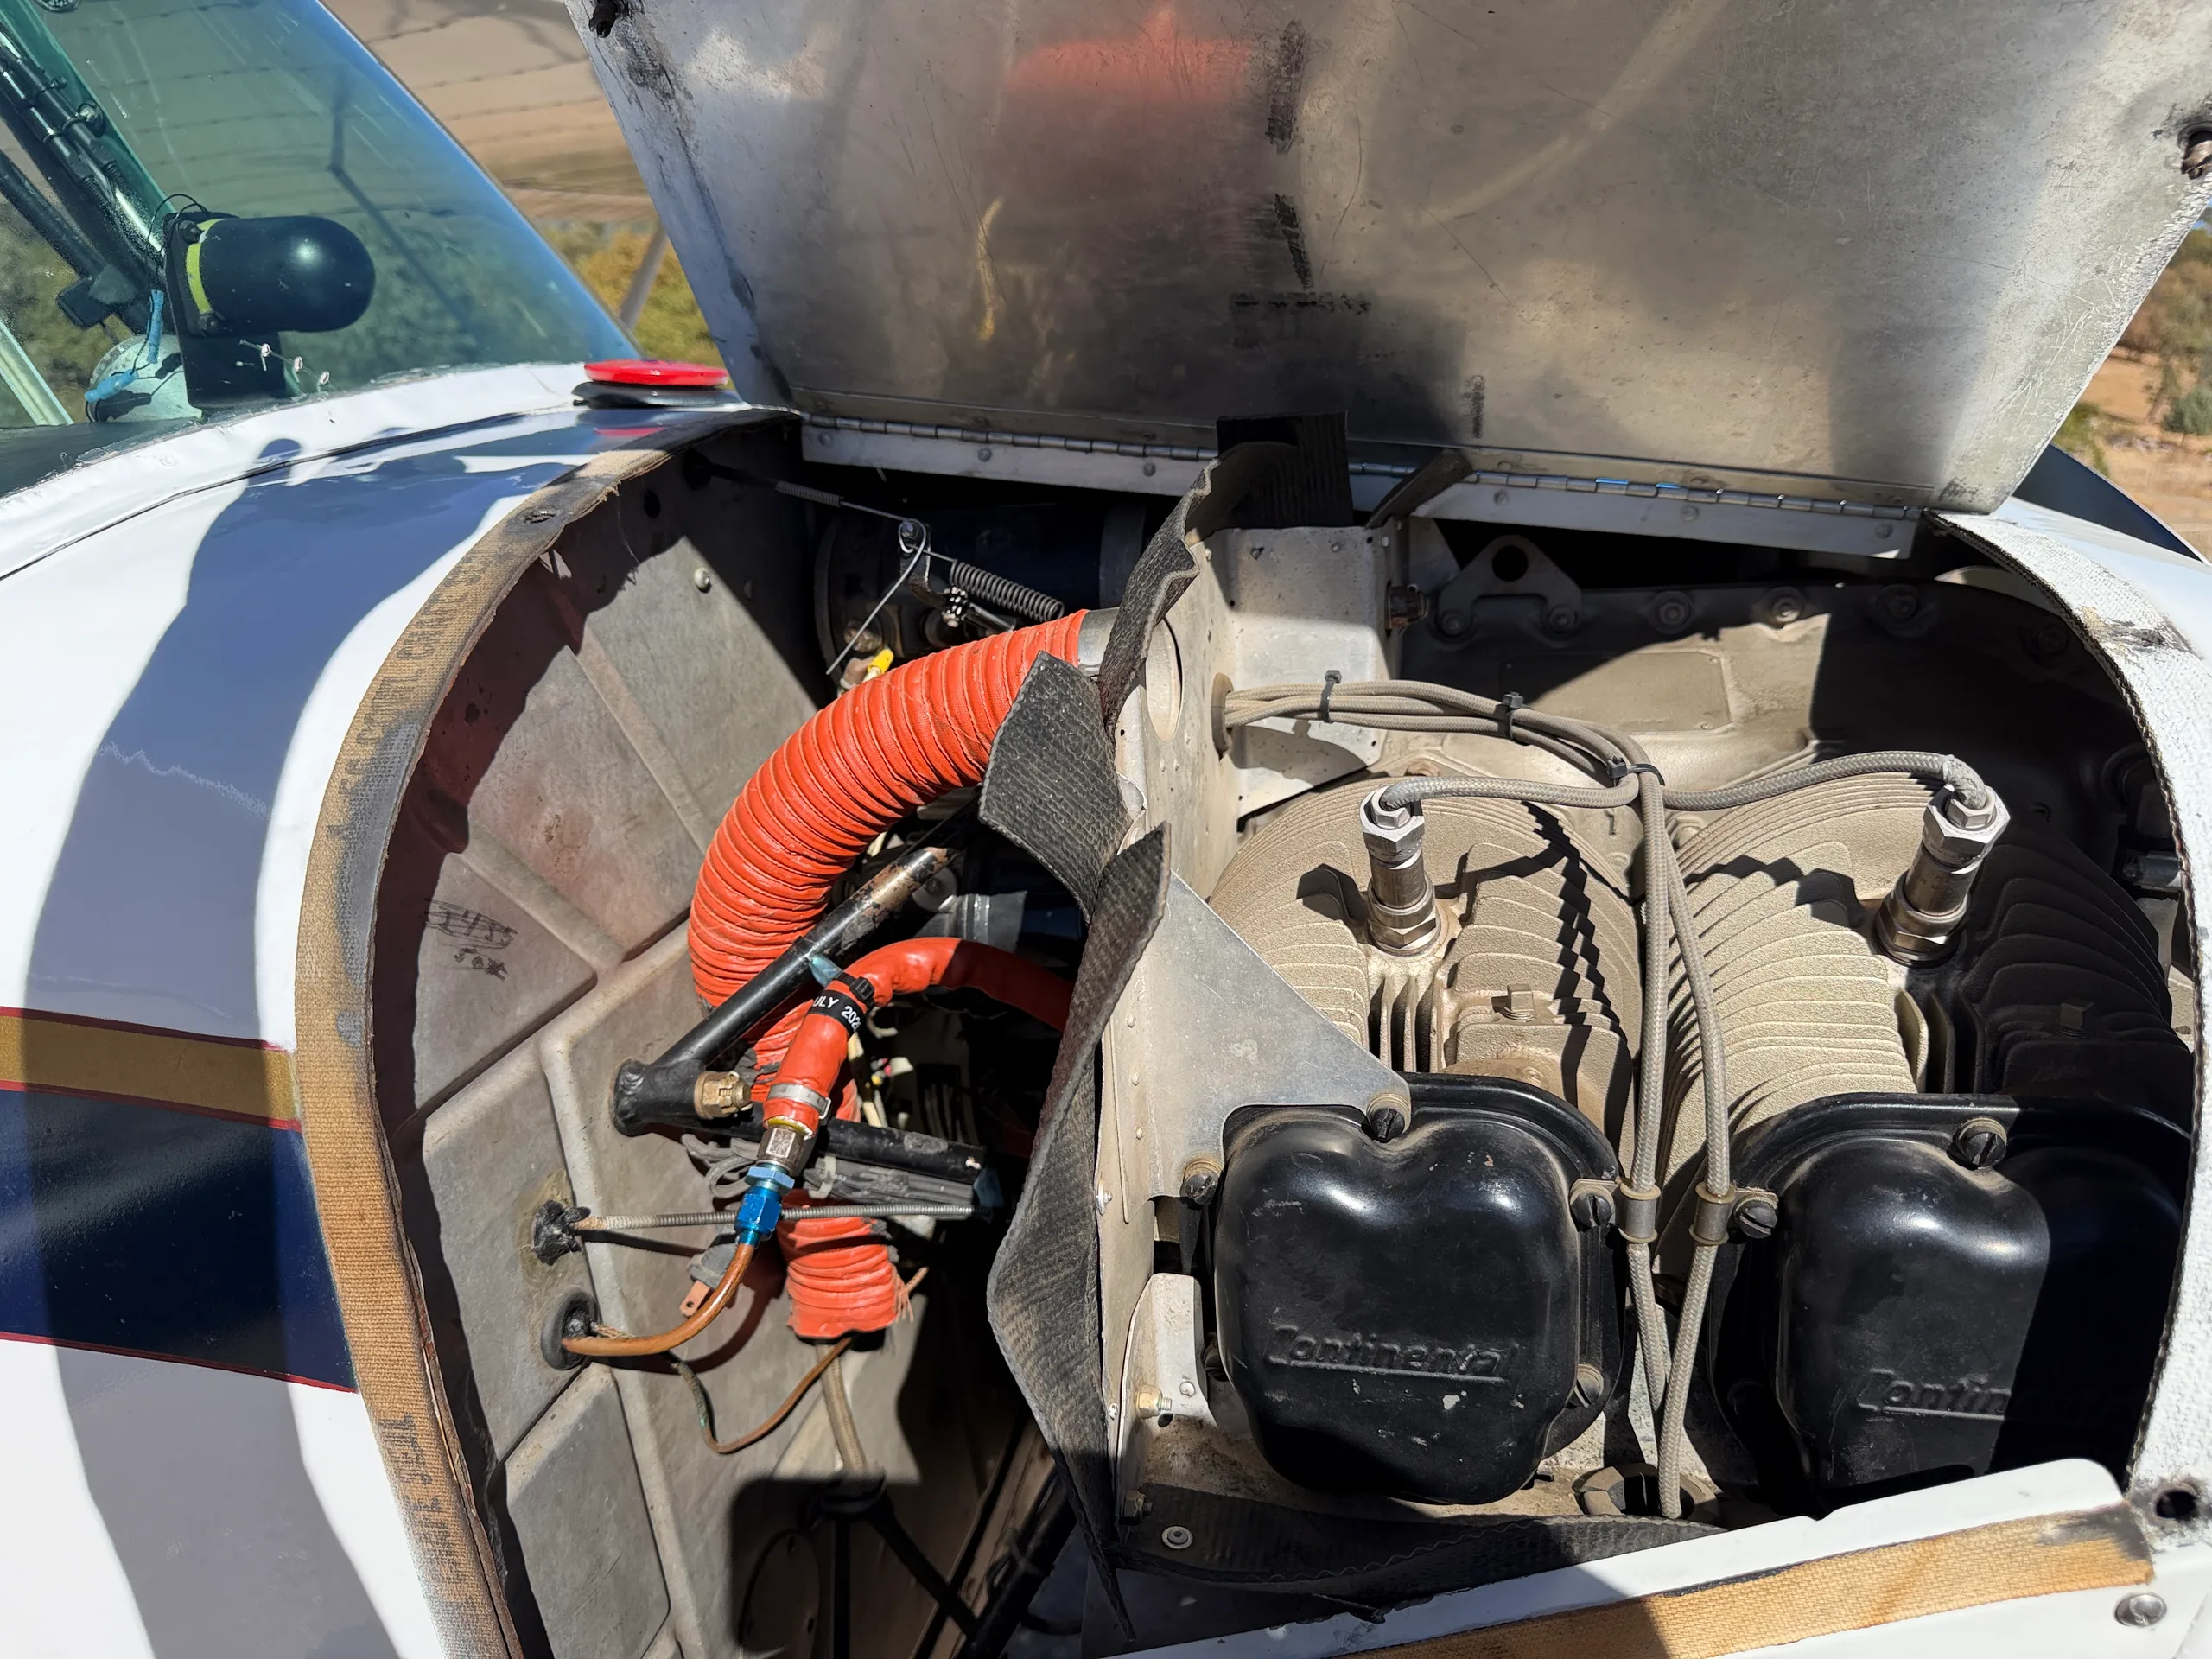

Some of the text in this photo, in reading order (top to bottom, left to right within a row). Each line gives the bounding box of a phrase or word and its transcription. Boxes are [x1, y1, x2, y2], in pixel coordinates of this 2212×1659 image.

[812, 995, 840, 1009] ULY
[1265, 1324, 1520, 1381] Continental
[1858, 1368, 2012, 1419] Contin
